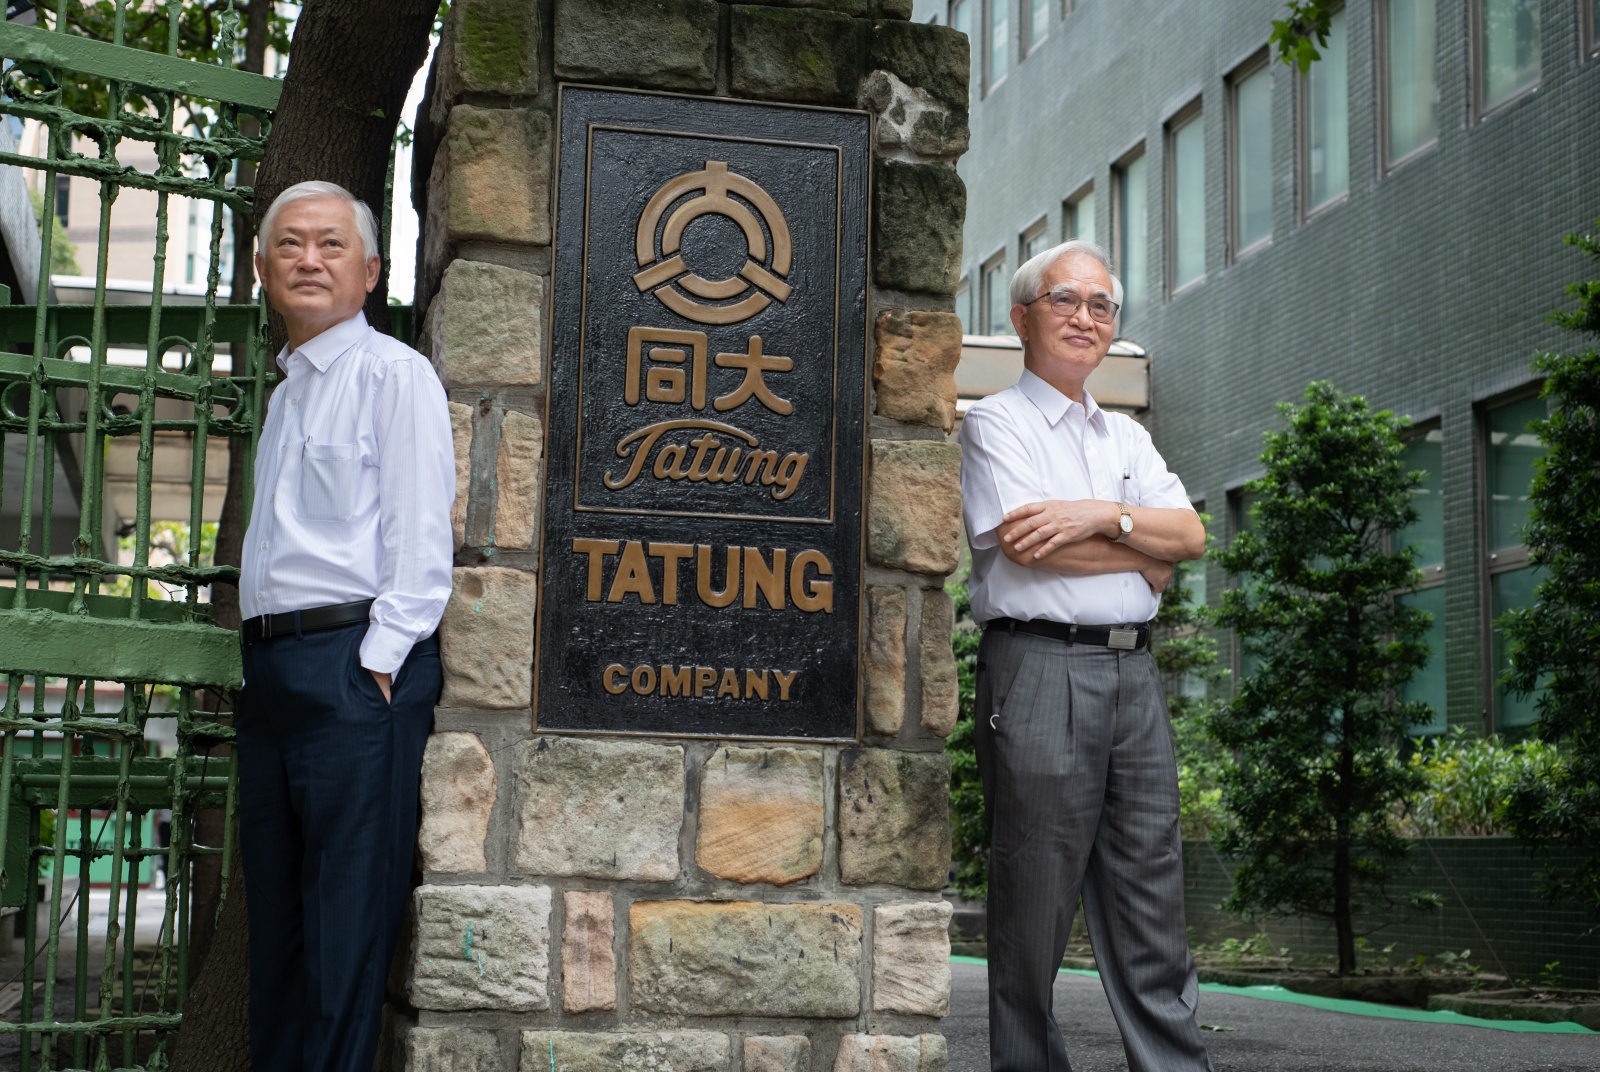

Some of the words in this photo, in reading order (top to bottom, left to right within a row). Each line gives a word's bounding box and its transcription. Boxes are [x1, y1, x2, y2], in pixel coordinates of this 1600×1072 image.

[603, 418, 809, 500] Tatung
[572, 538, 833, 614] TATUNG
[603, 664, 799, 701] COMPANY
